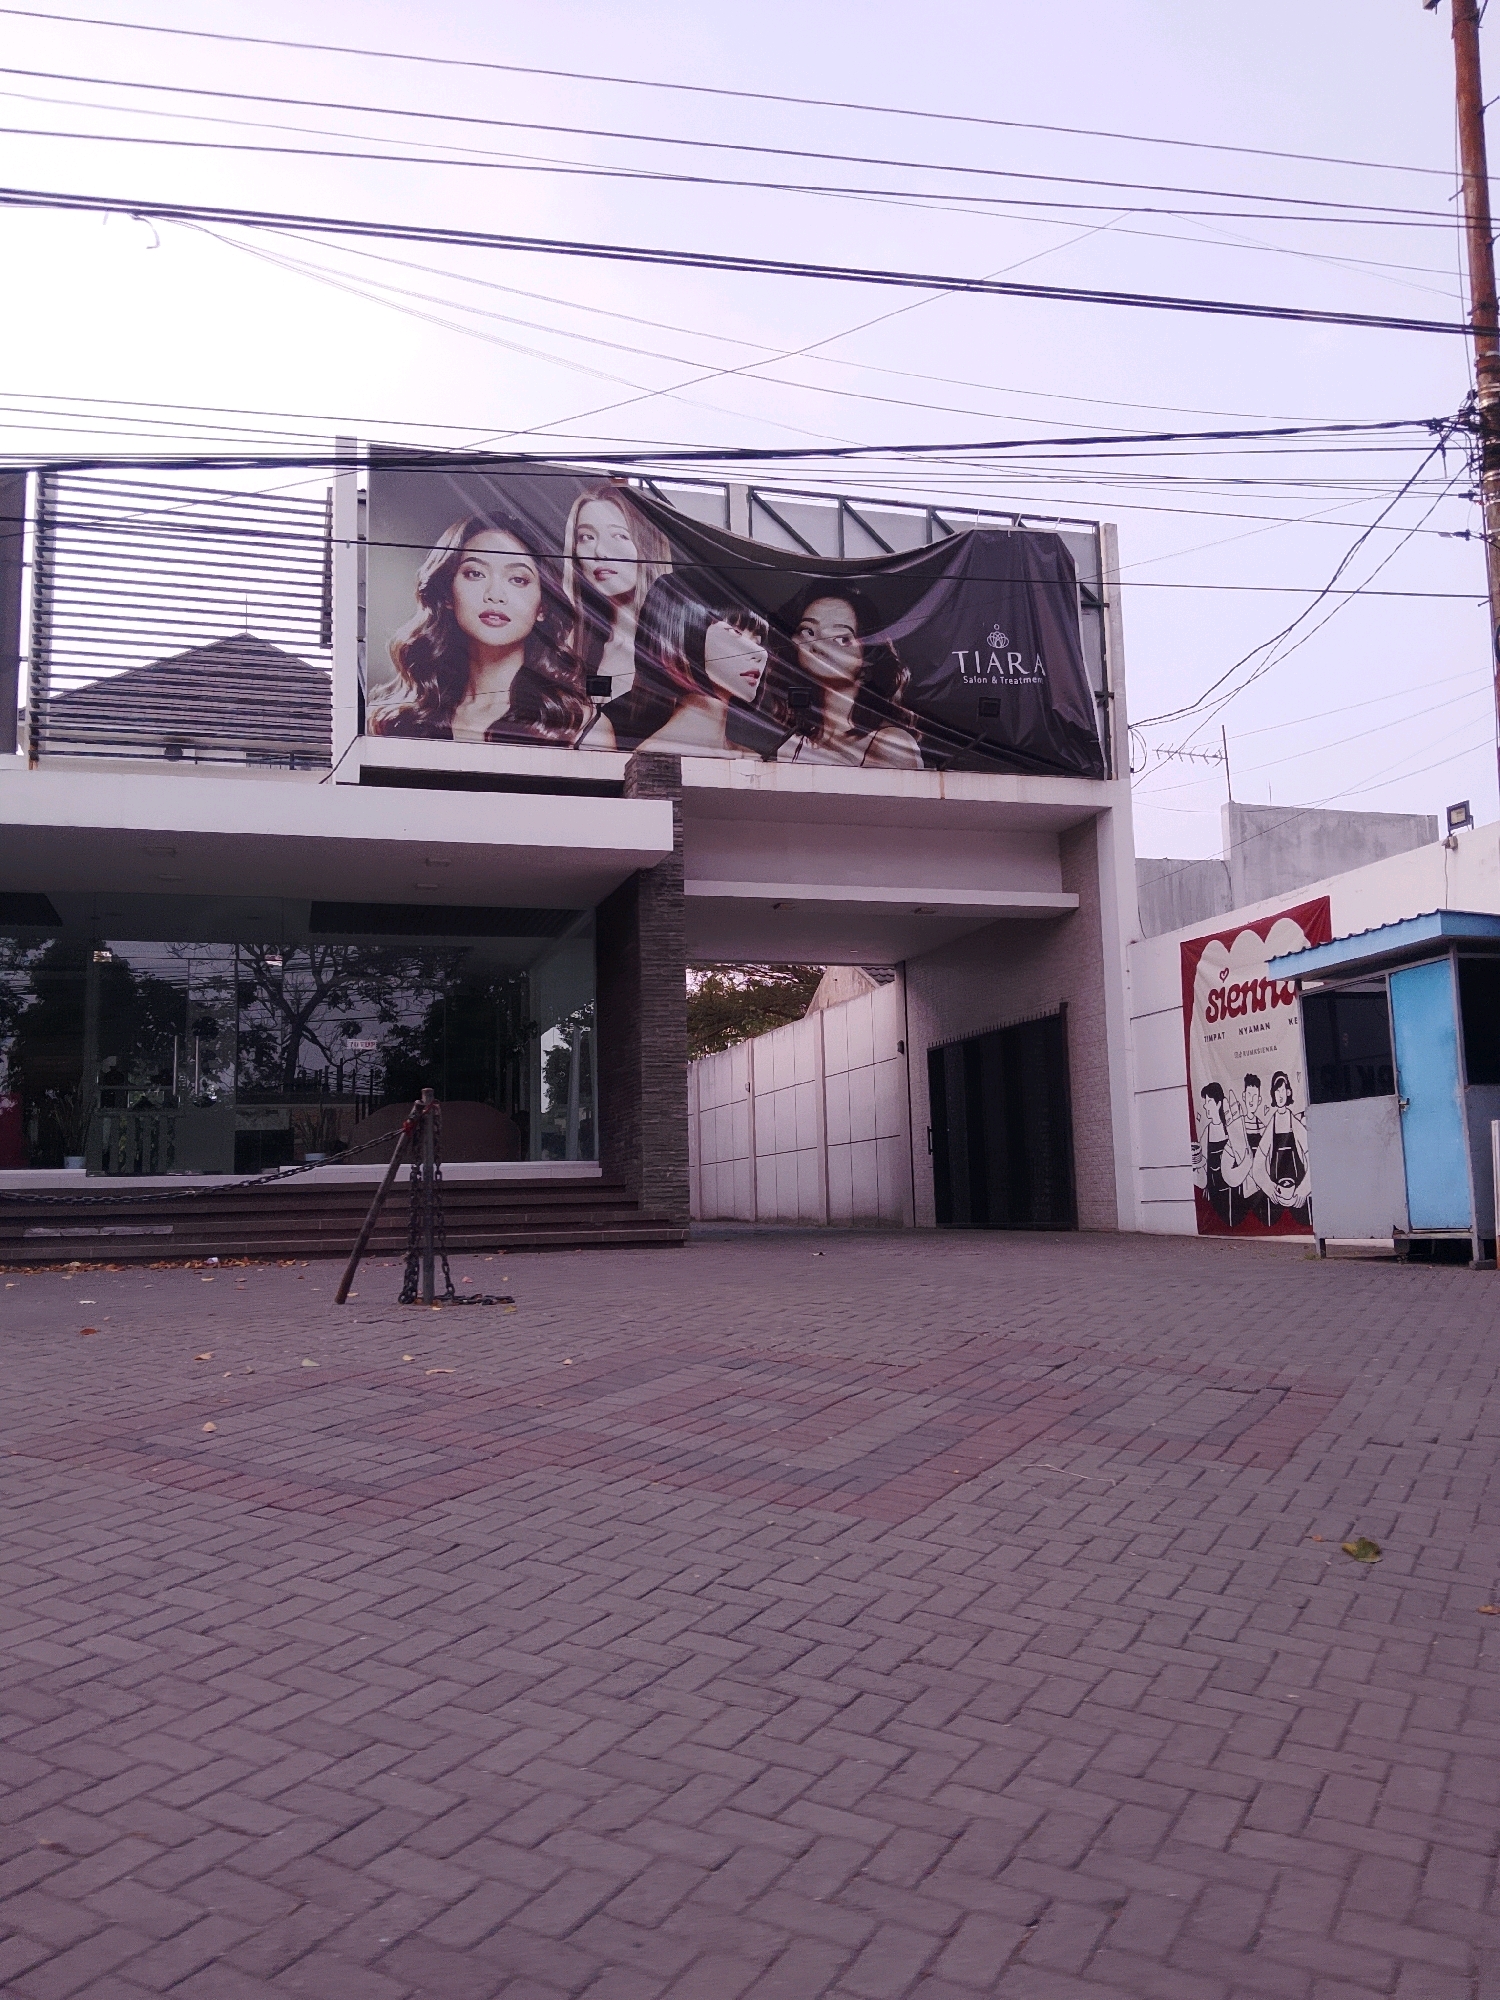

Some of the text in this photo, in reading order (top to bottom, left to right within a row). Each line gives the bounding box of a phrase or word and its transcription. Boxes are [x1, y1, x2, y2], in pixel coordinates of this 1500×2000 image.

[951, 650, 1046, 677] TIARA
[963, 675, 1044, 685] Salon & Treatmen
[1238, 1021, 1271, 1036] NYAMAN
